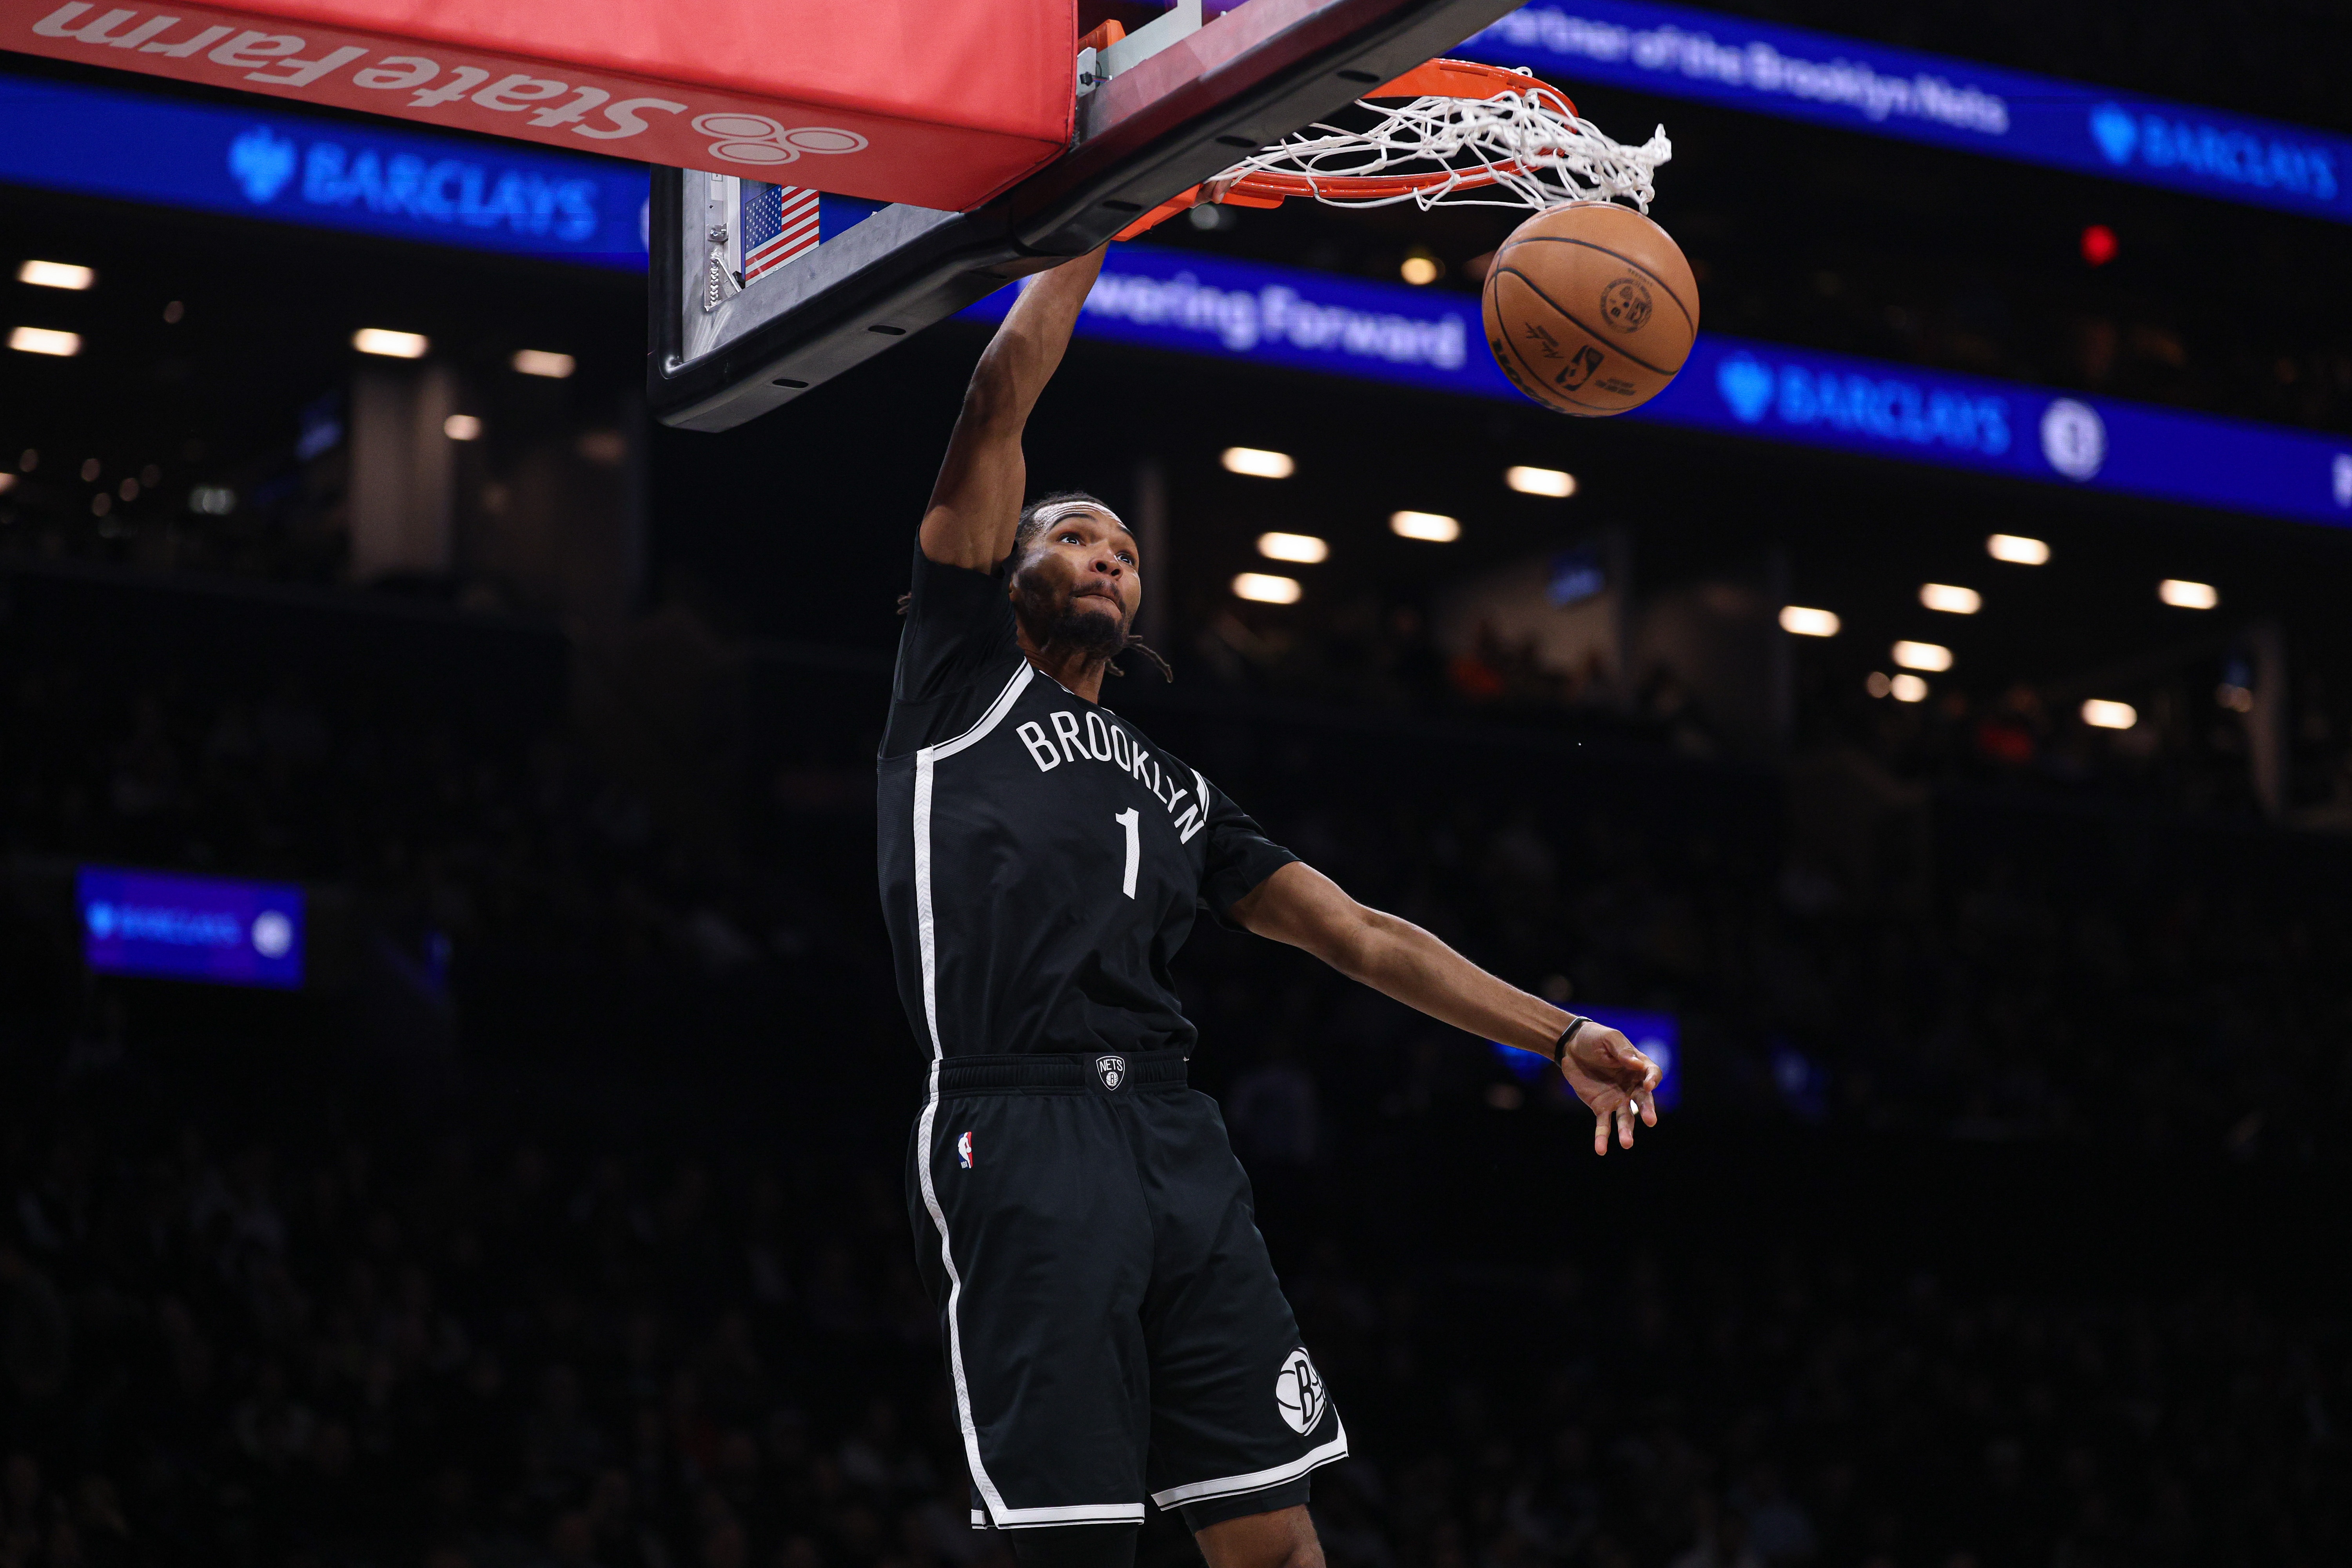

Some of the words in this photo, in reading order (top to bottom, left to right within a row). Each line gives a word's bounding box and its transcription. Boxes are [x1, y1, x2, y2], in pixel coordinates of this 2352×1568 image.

[1632, 24, 1682, 73] of
[1681, 31, 1748, 86] the
[1744, 41, 1912, 122] Brooklyn
[1915, 72, 2010, 136] Nets
[302, 141, 597, 241] BARCLAYS
[2141, 113, 2337, 200] BARCLAYS
[1257, 283, 1467, 372] Forward
[1777, 364, 2011, 456] BARCLAYS
[1016, 711, 1205, 845] BROOKLYN
[1115, 807, 1140, 900] 1
[1100, 1059, 1123, 1073] NETS
[1294, 1360, 1315, 1425] B
